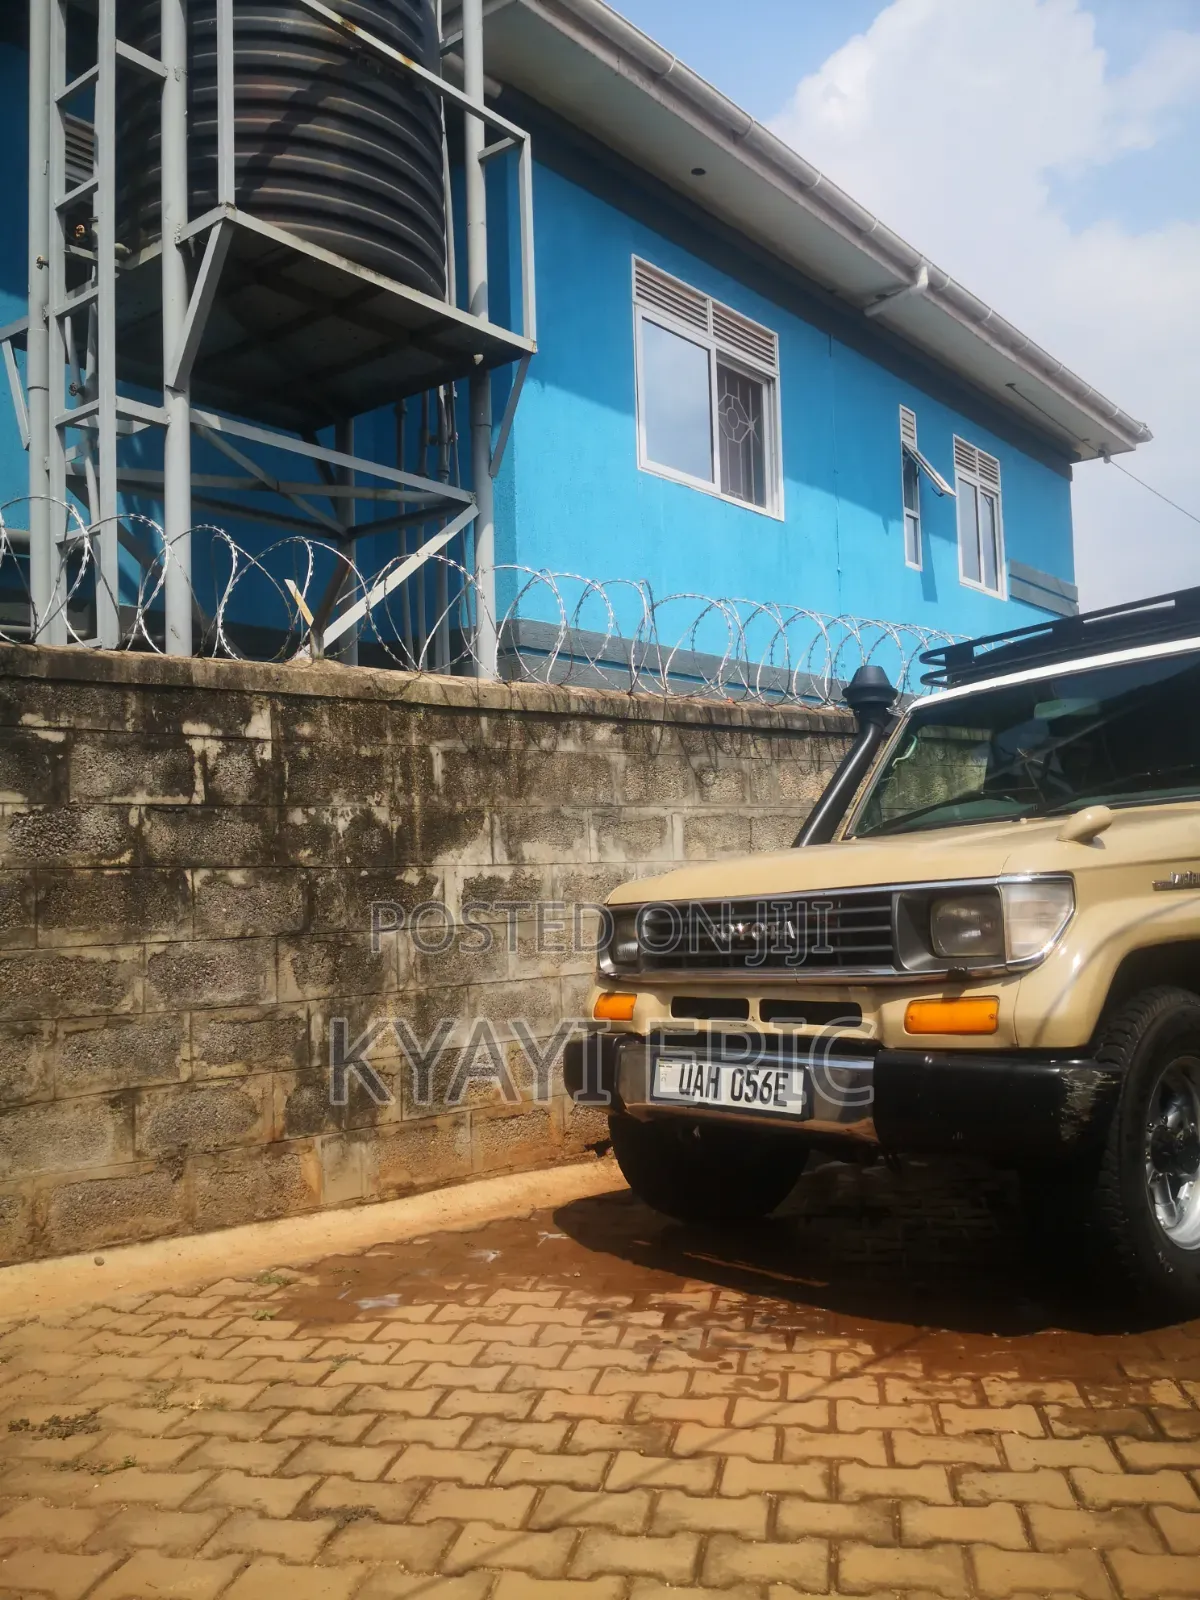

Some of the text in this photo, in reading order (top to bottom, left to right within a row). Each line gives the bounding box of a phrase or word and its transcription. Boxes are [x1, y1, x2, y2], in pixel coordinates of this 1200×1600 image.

[711, 920, 796, 941] TOYOTA
[678, 1064, 789, 1107] UAH 056E
